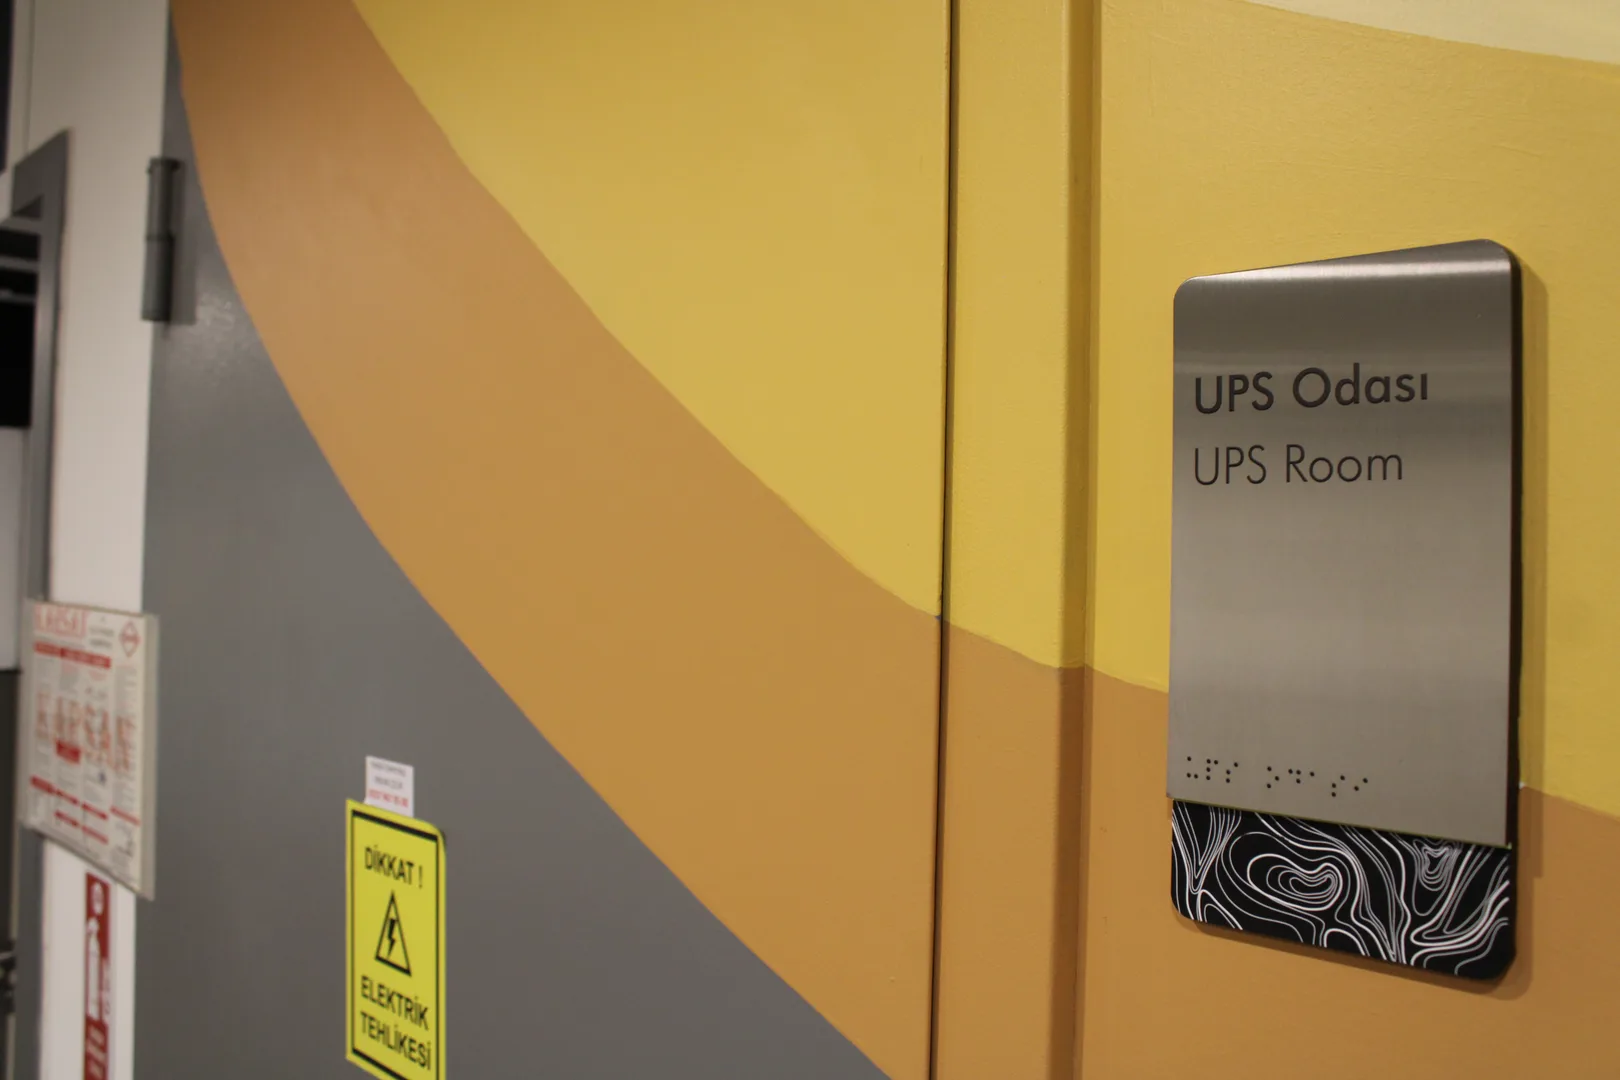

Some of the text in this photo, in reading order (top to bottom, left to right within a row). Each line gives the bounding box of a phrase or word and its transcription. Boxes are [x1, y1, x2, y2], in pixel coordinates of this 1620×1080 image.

[1195, 362, 1428, 415] UPS Odası
[1194, 443, 1403, 486] UPS Room
[365, 844, 423, 889] DİKKAT !
[361, 975, 429, 1031] ELEKTRİK
[361, 1011, 431, 1071] TEHLİKESİ
